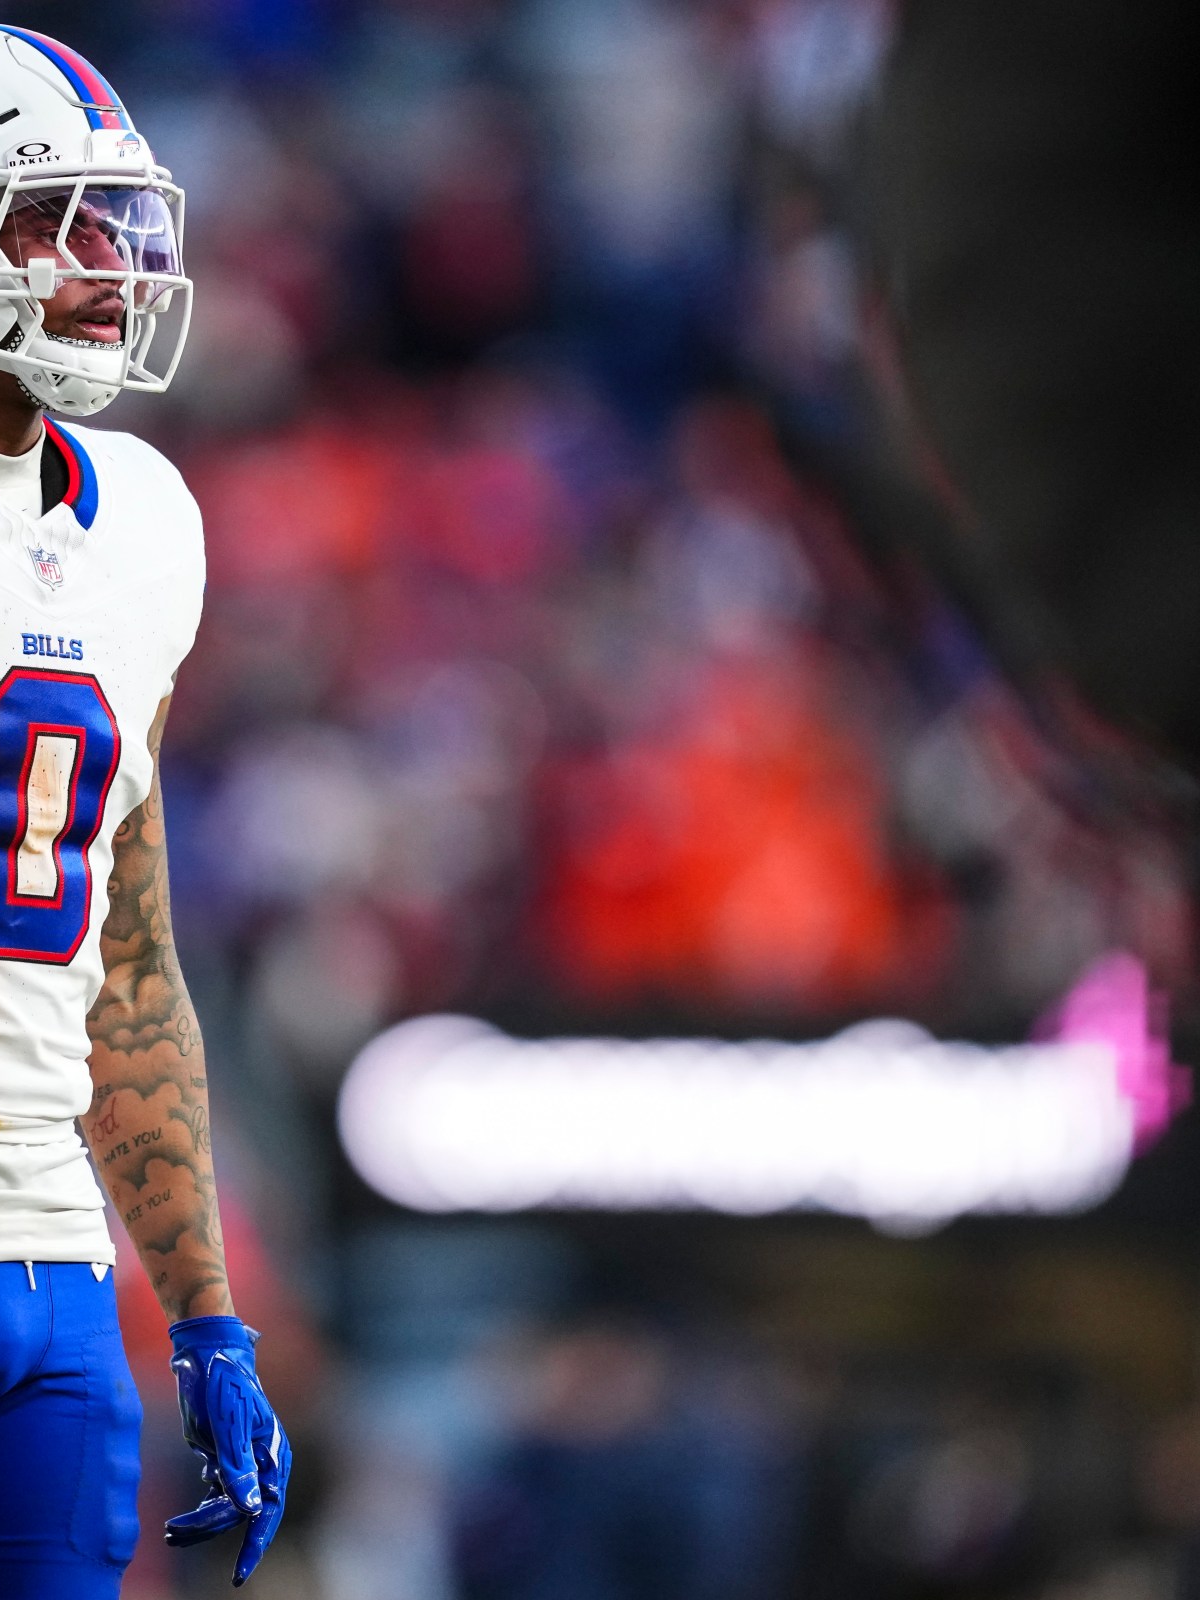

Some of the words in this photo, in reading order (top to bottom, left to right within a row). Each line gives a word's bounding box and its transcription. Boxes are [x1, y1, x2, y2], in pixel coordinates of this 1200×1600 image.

[9, 155, 61, 167] OAKLEY
[38, 562, 61, 580] NFL
[20, 632, 83, 661] BILLS
